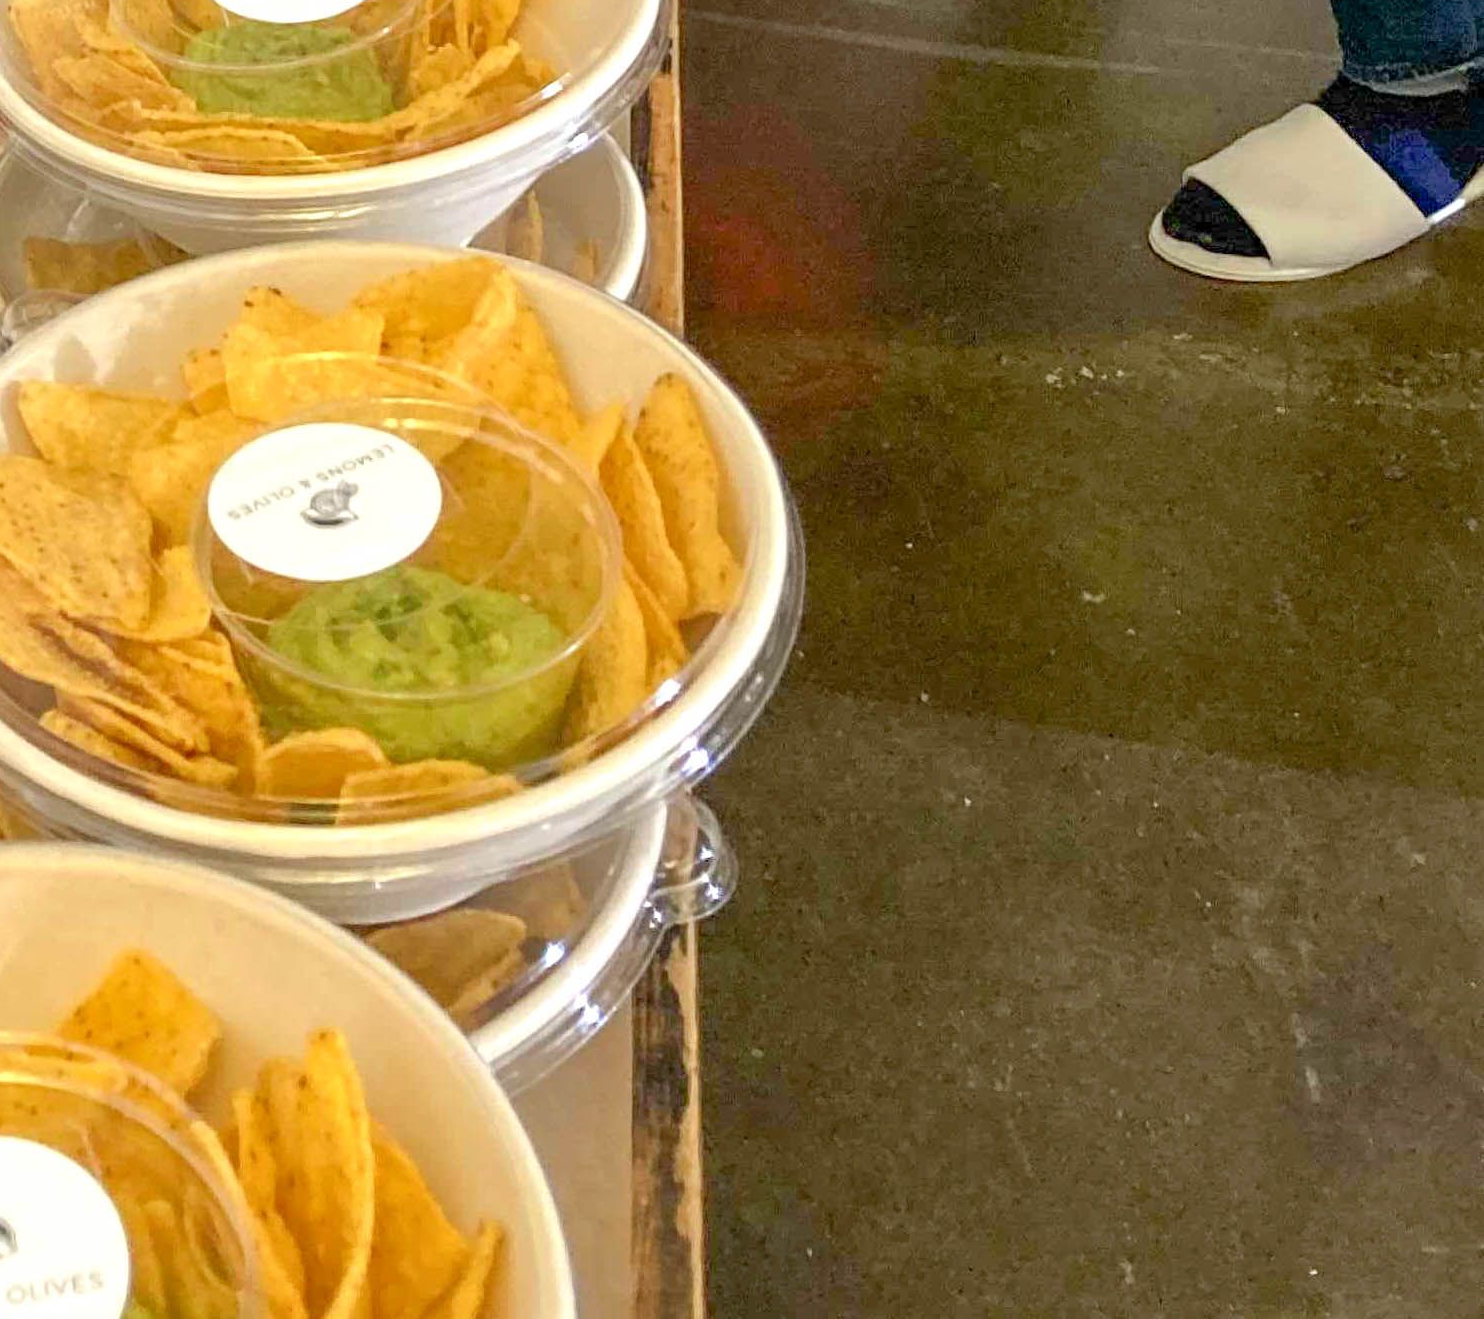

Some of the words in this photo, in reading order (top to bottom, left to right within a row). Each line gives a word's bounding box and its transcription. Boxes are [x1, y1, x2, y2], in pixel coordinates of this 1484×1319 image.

[315, 443, 397, 483] LEMONS
[227, 485, 296, 521] OLIVES
[6, 1272, 105, 1307] OLIVES
